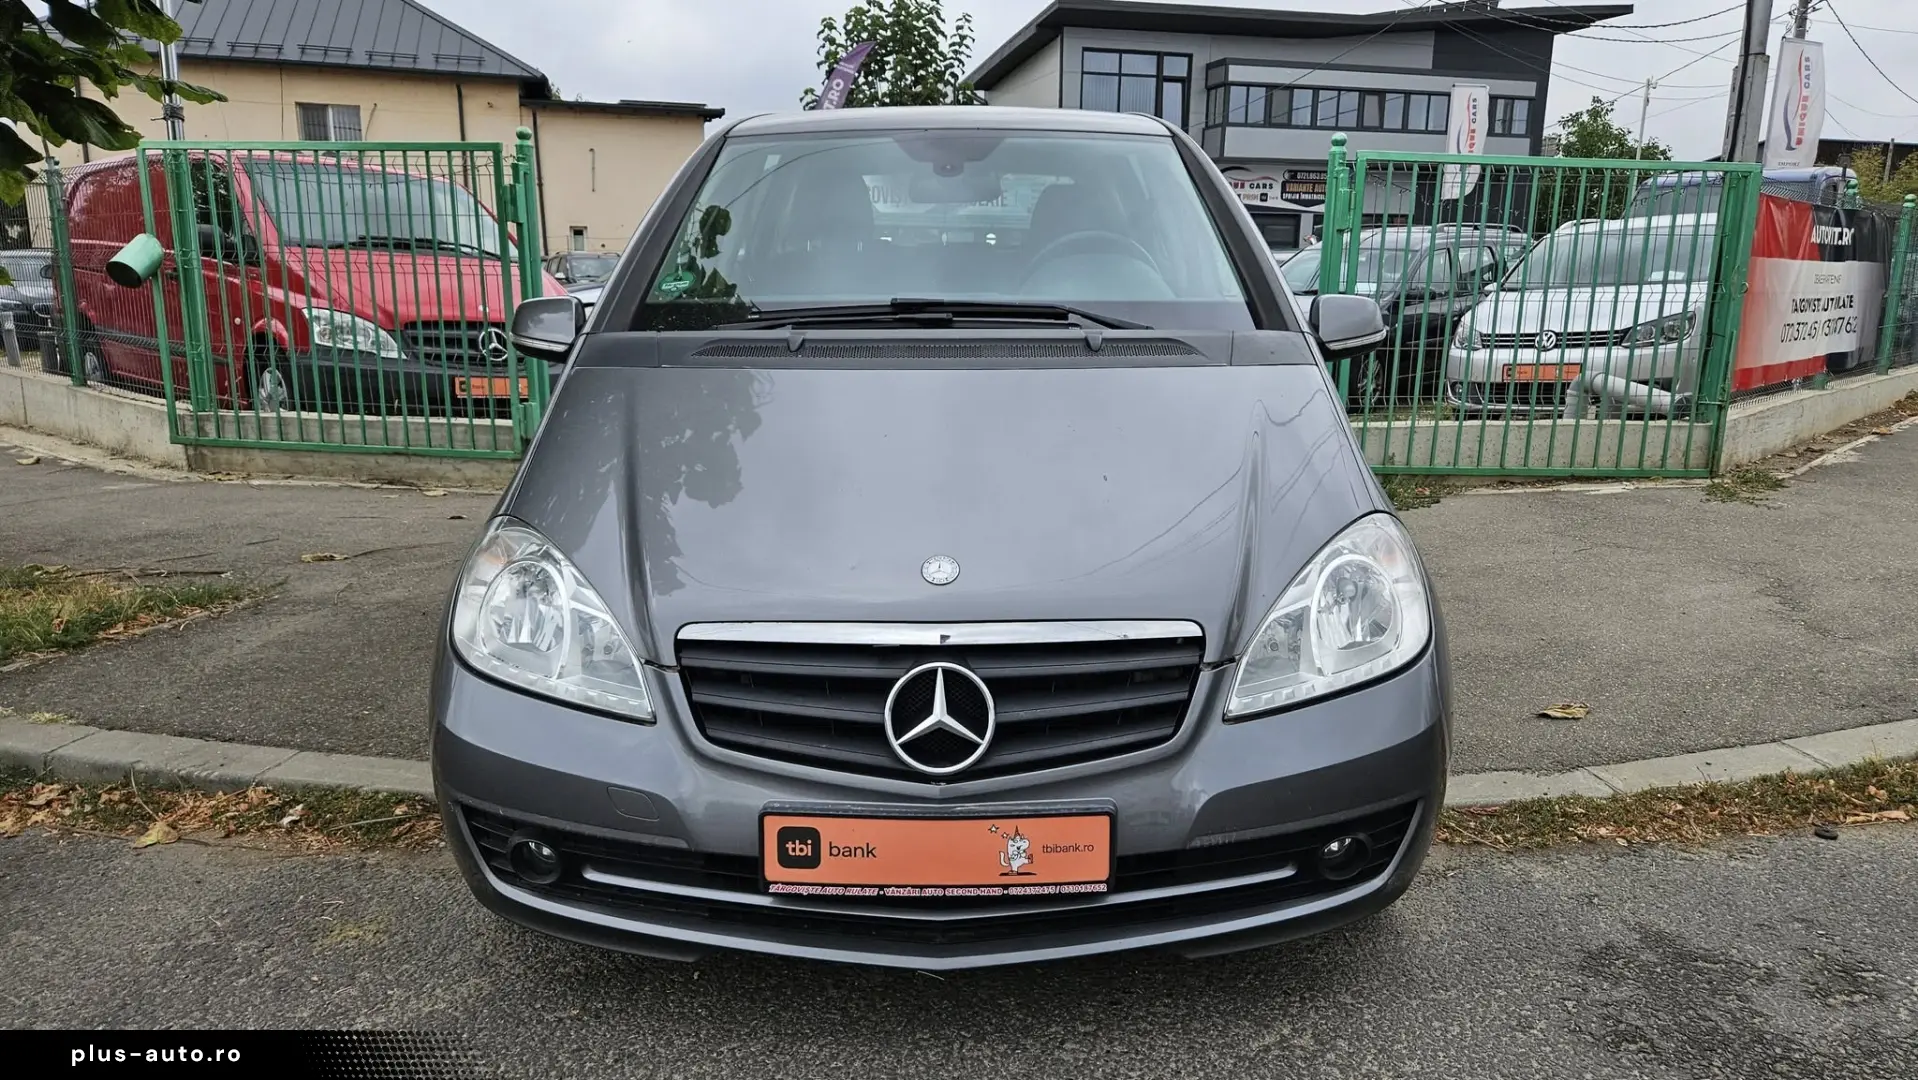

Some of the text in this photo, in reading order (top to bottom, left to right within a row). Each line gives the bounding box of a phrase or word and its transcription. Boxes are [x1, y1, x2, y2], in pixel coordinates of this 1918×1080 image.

[1803, 56, 1811, 89] CARS
[1314, 183, 1328, 193] AUT
[785, 839, 877, 858] tbi bank
[1042, 843, 1095, 854] tbibank.ro
[822, 886, 845, 895] AUTO
[845, 887, 879, 896] RULATE
[921, 888, 945, 896] AUTO
